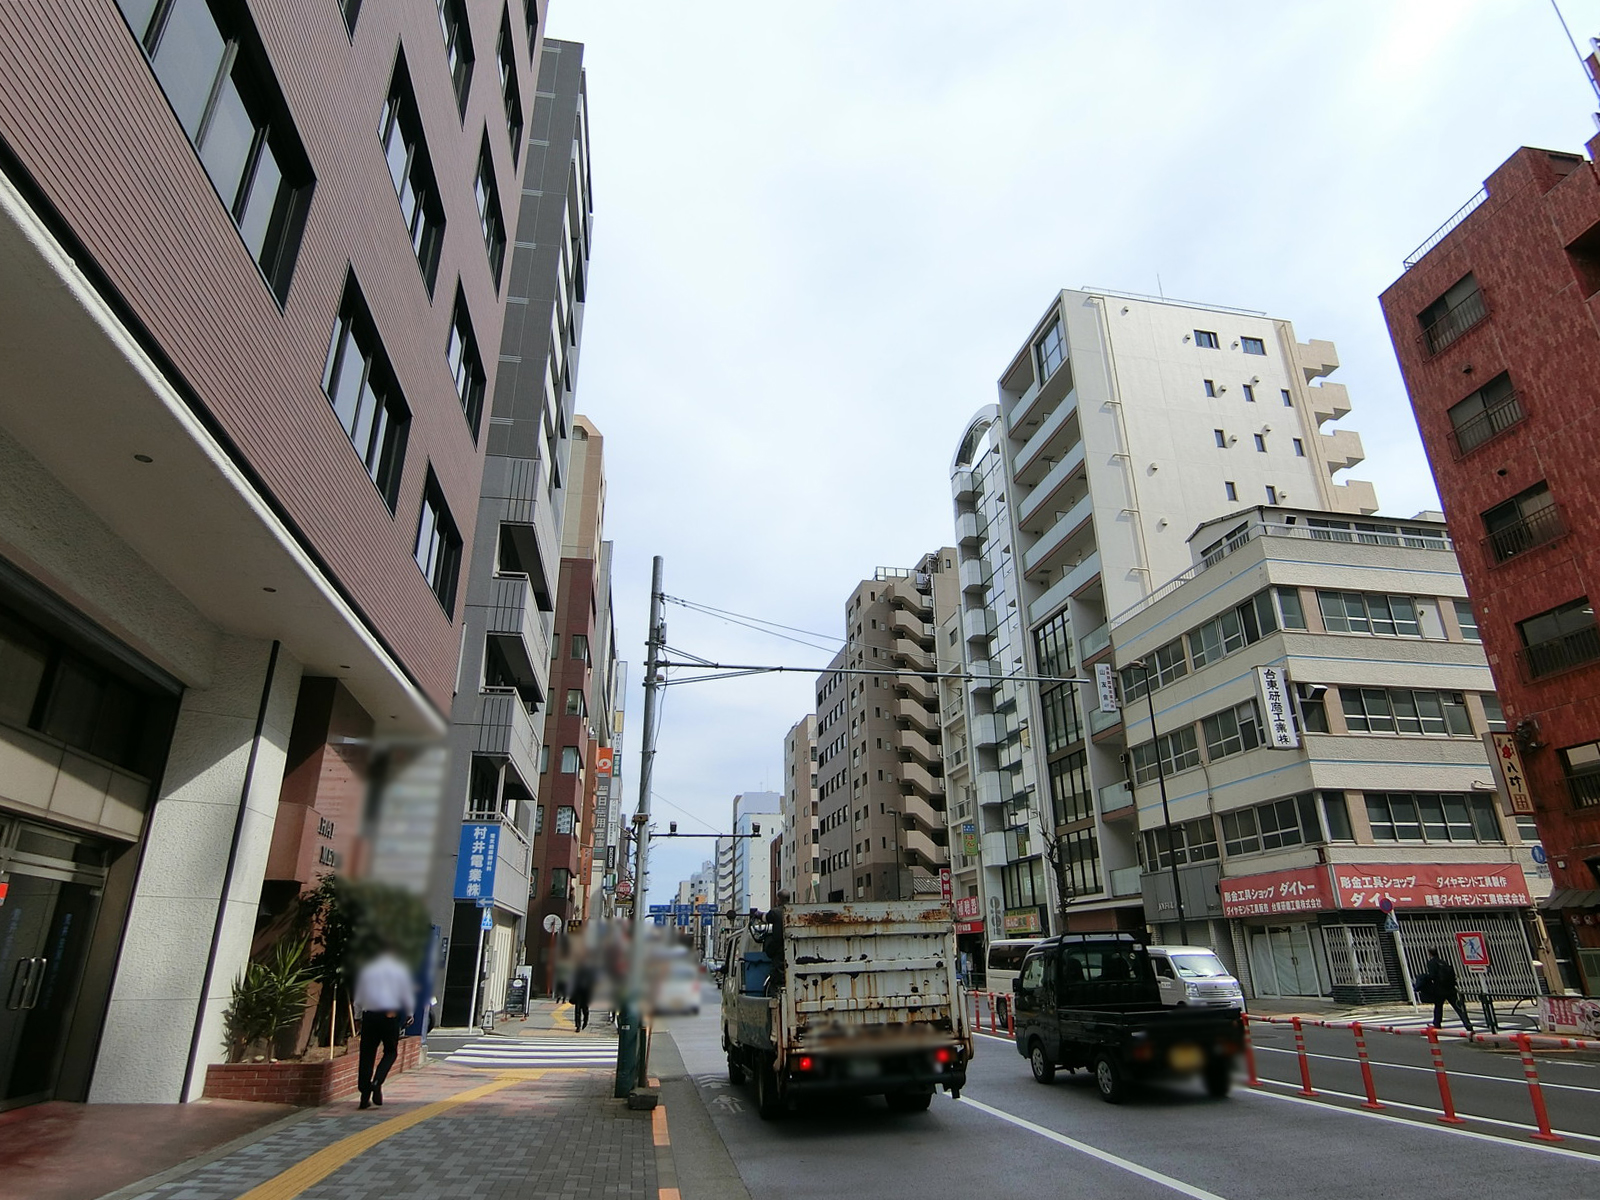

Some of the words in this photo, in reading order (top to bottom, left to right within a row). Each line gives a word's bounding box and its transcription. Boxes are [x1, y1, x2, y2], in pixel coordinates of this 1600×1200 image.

[1279, 880, 1316, 897] ダイトー
[1340, 875, 1416, 890] 彫金工具ショップ
[1436, 875, 1507, 888] ダイヤモンド工具製作
[1223, 886, 1275, 903] 彫金工具ショップ
[1350, 891, 1413, 908] ダイトー
[1424, 893, 1528, 906] 産業ダイヤモンド工業株式会社
[1226, 903, 1269, 916] ダイヤモンド工具販売
[1271, 897, 1323, 913] 台東研磨工業株式会社
